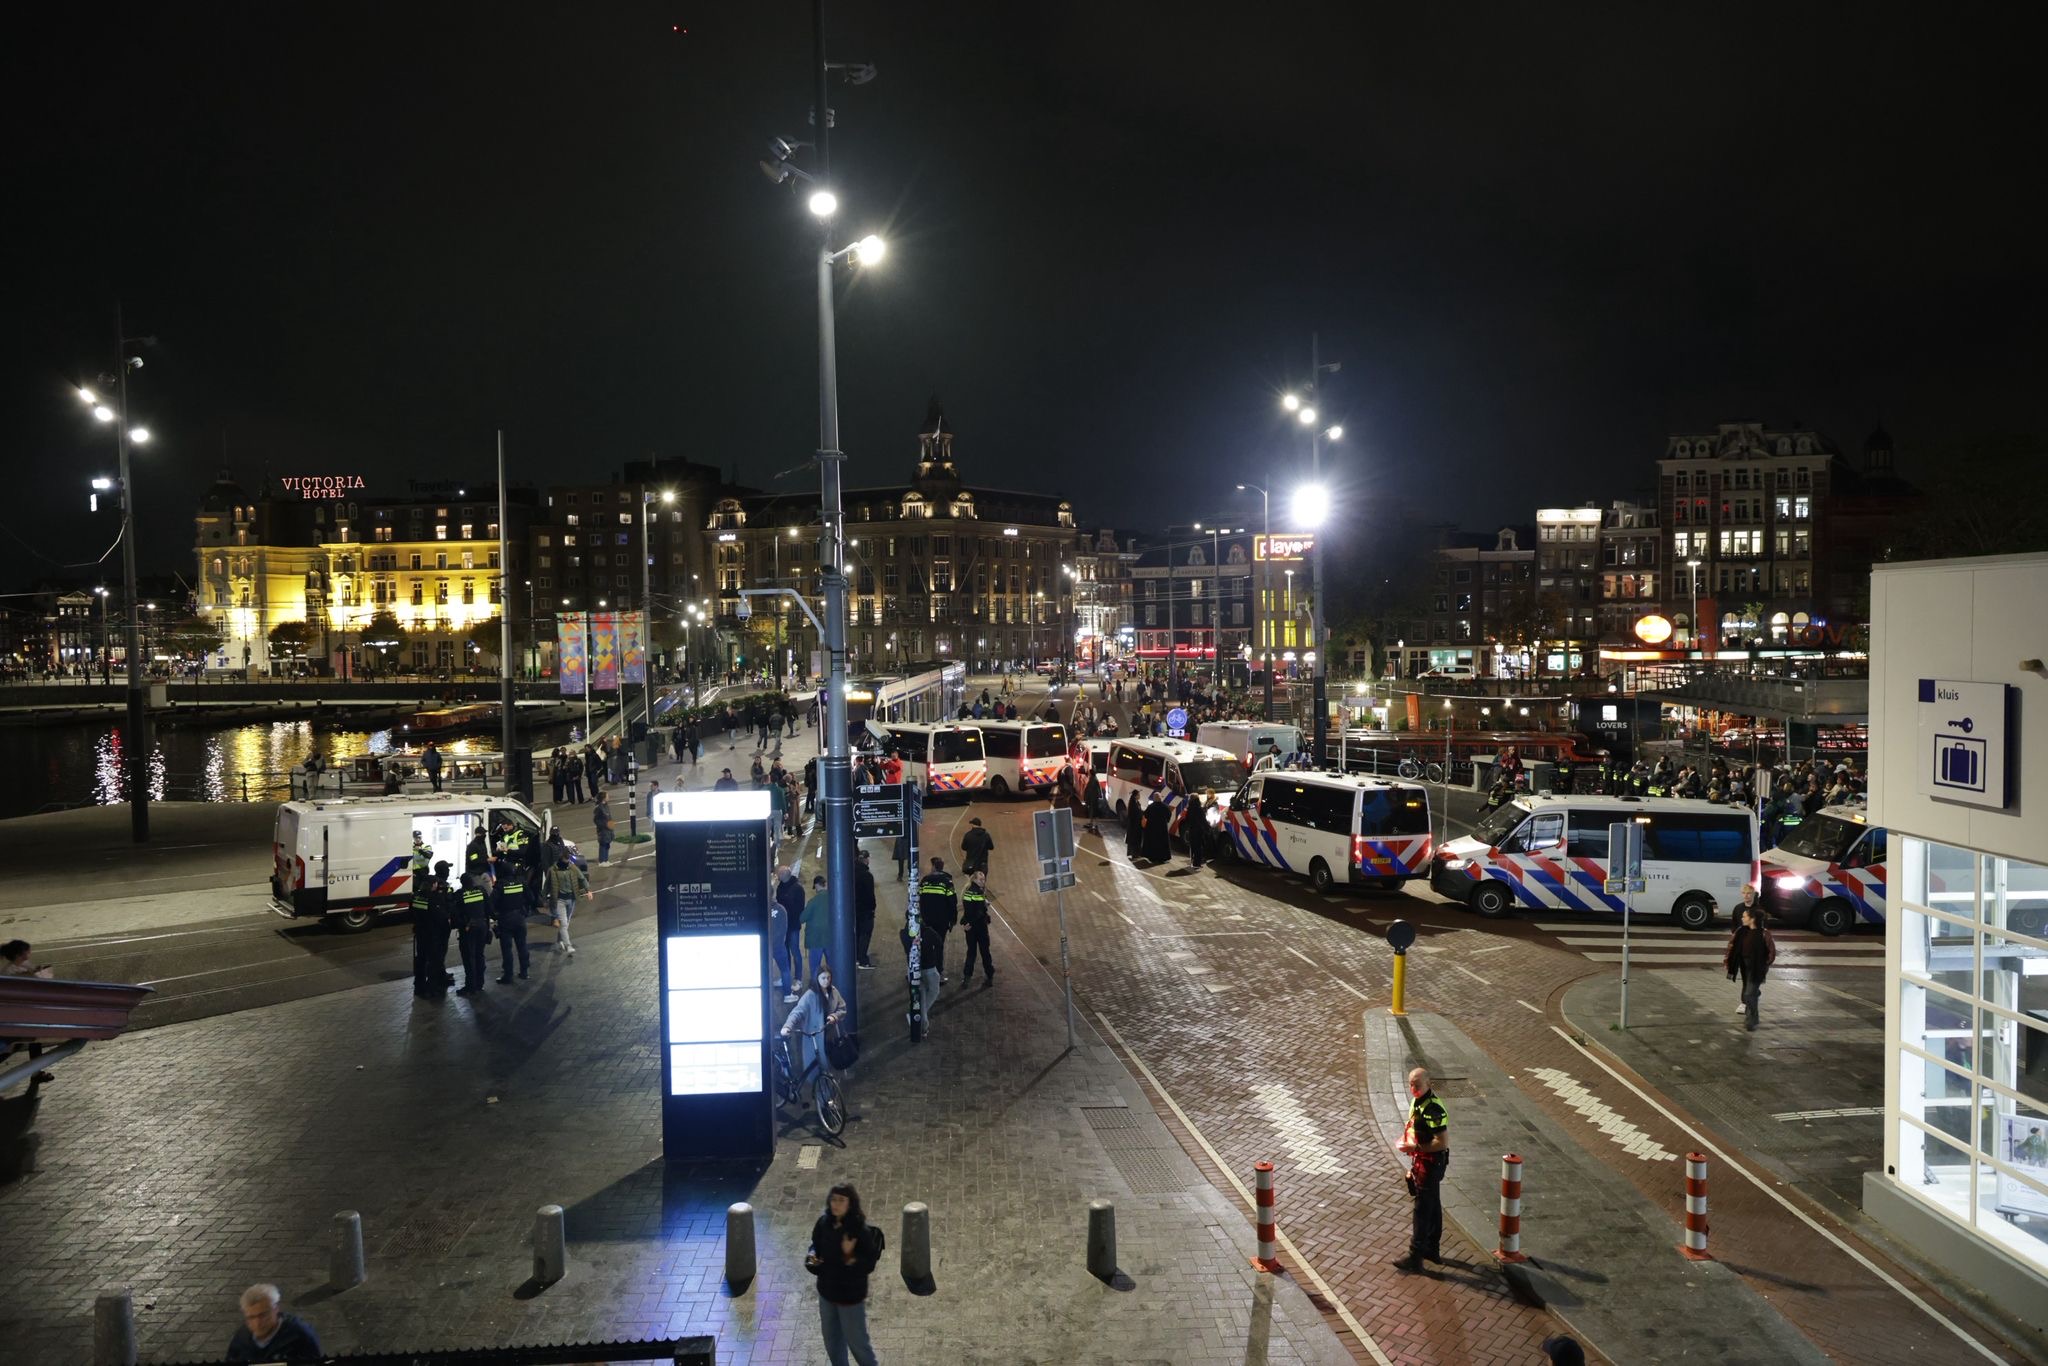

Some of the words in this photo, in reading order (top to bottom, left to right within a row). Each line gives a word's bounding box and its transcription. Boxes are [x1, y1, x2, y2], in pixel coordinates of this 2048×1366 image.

[282, 475, 365, 489] VICTORIA
[302, 488, 345, 499] HOTEL
[1937, 688, 1959, 701] kluis
[1596, 721, 1628, 729] LOVERS
